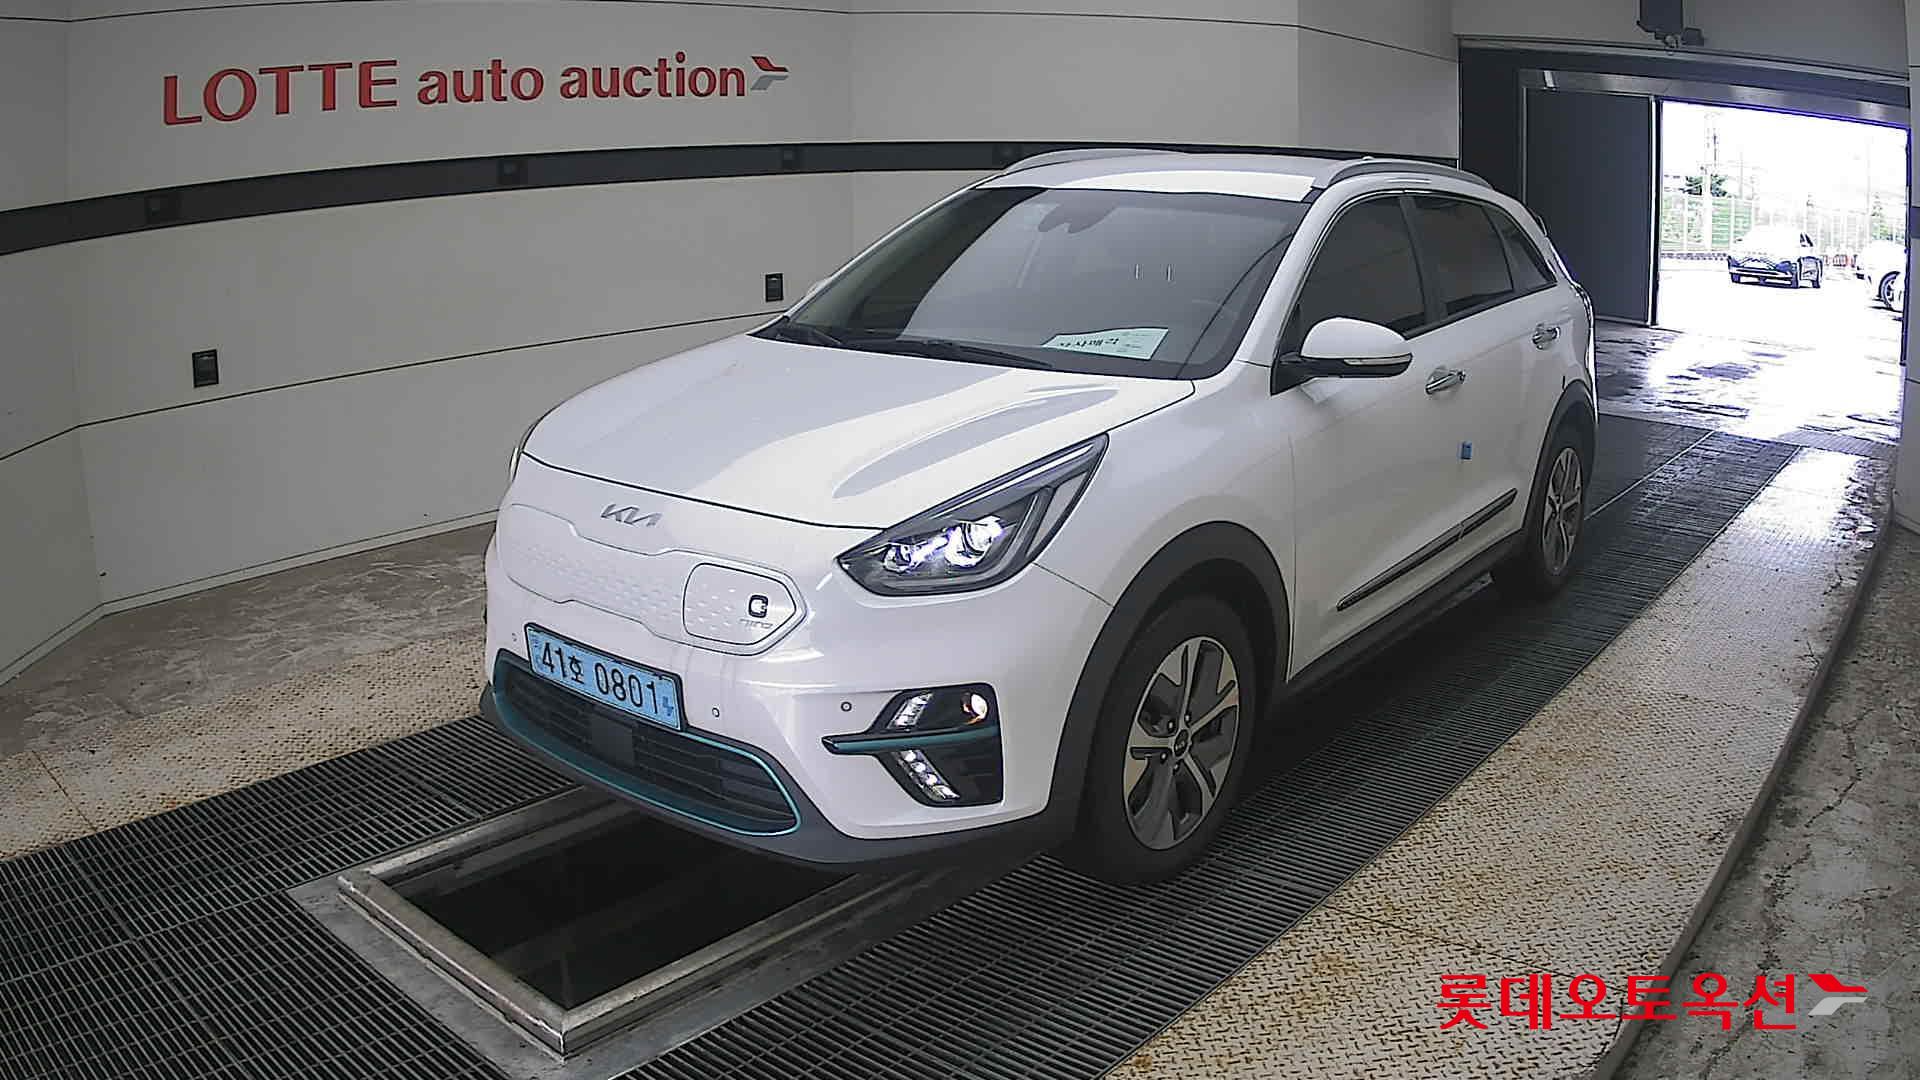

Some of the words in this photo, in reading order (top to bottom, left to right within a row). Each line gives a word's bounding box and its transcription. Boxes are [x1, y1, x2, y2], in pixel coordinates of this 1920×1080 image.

[163, 59, 398, 126] LOTTE
[416, 58, 545, 105] auto
[559, 50, 746, 99] auction
[542, 642, 585, 685] 41호
[594, 662, 659, 715] 0801
